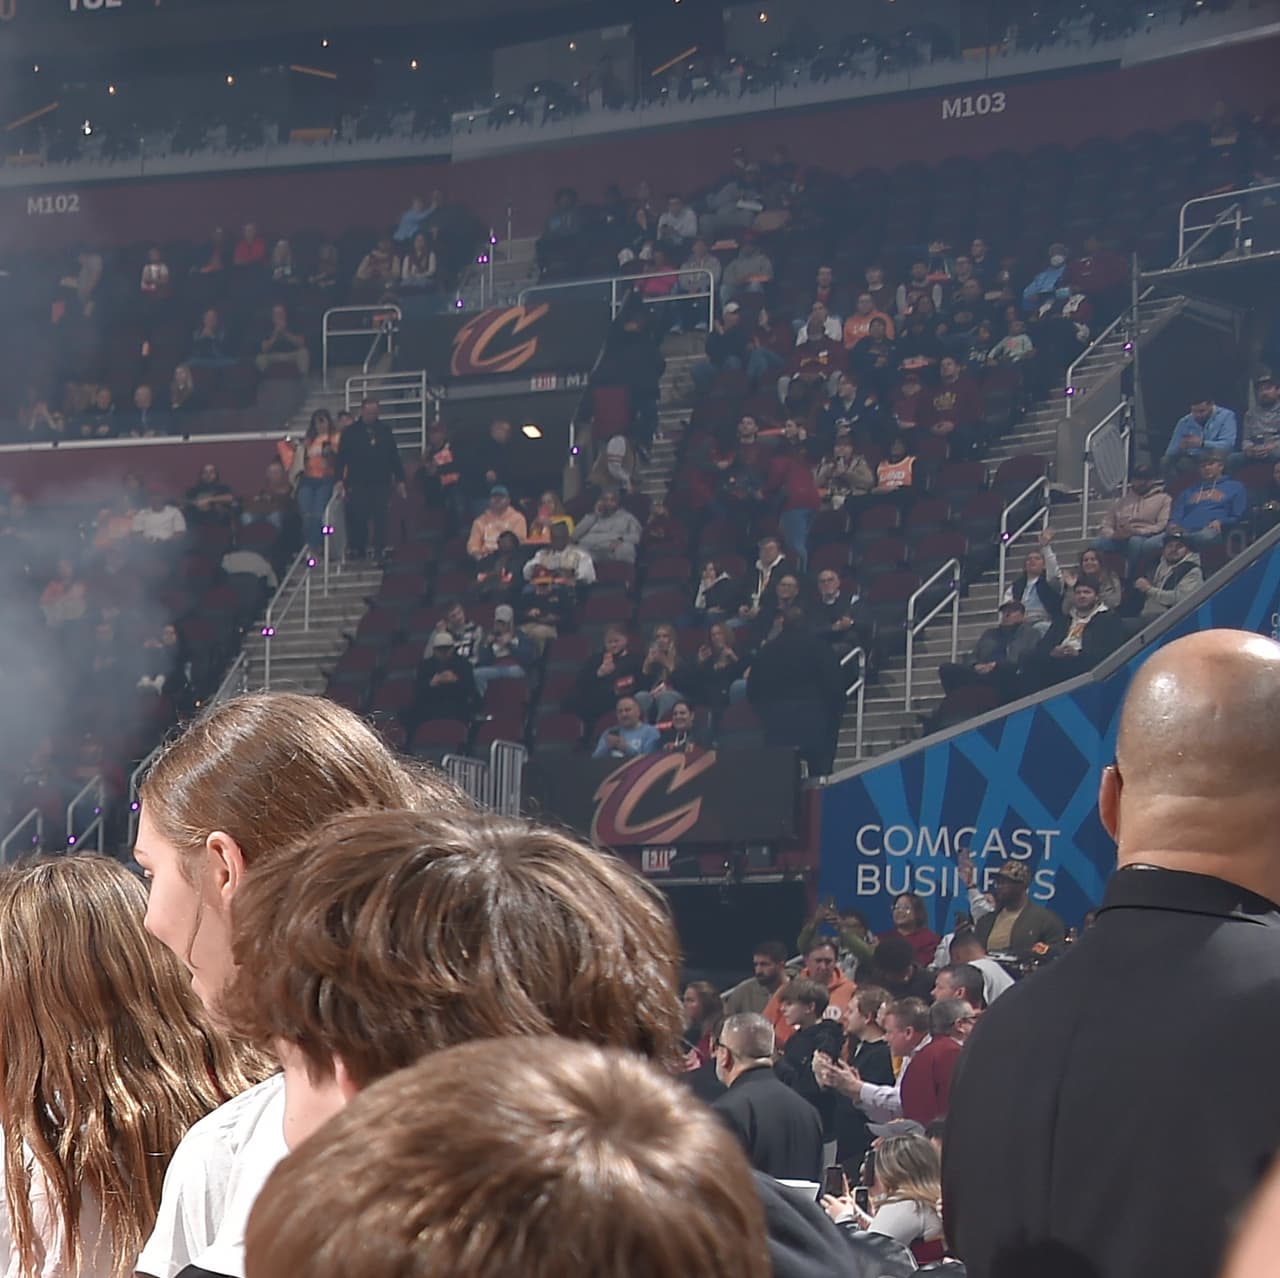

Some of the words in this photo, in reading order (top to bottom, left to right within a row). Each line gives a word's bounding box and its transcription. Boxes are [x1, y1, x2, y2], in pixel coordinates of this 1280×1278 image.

[941, 92, 1006, 120] M103
[28, 194, 80, 215] M102
[855, 824, 1061, 861] COMCAST
